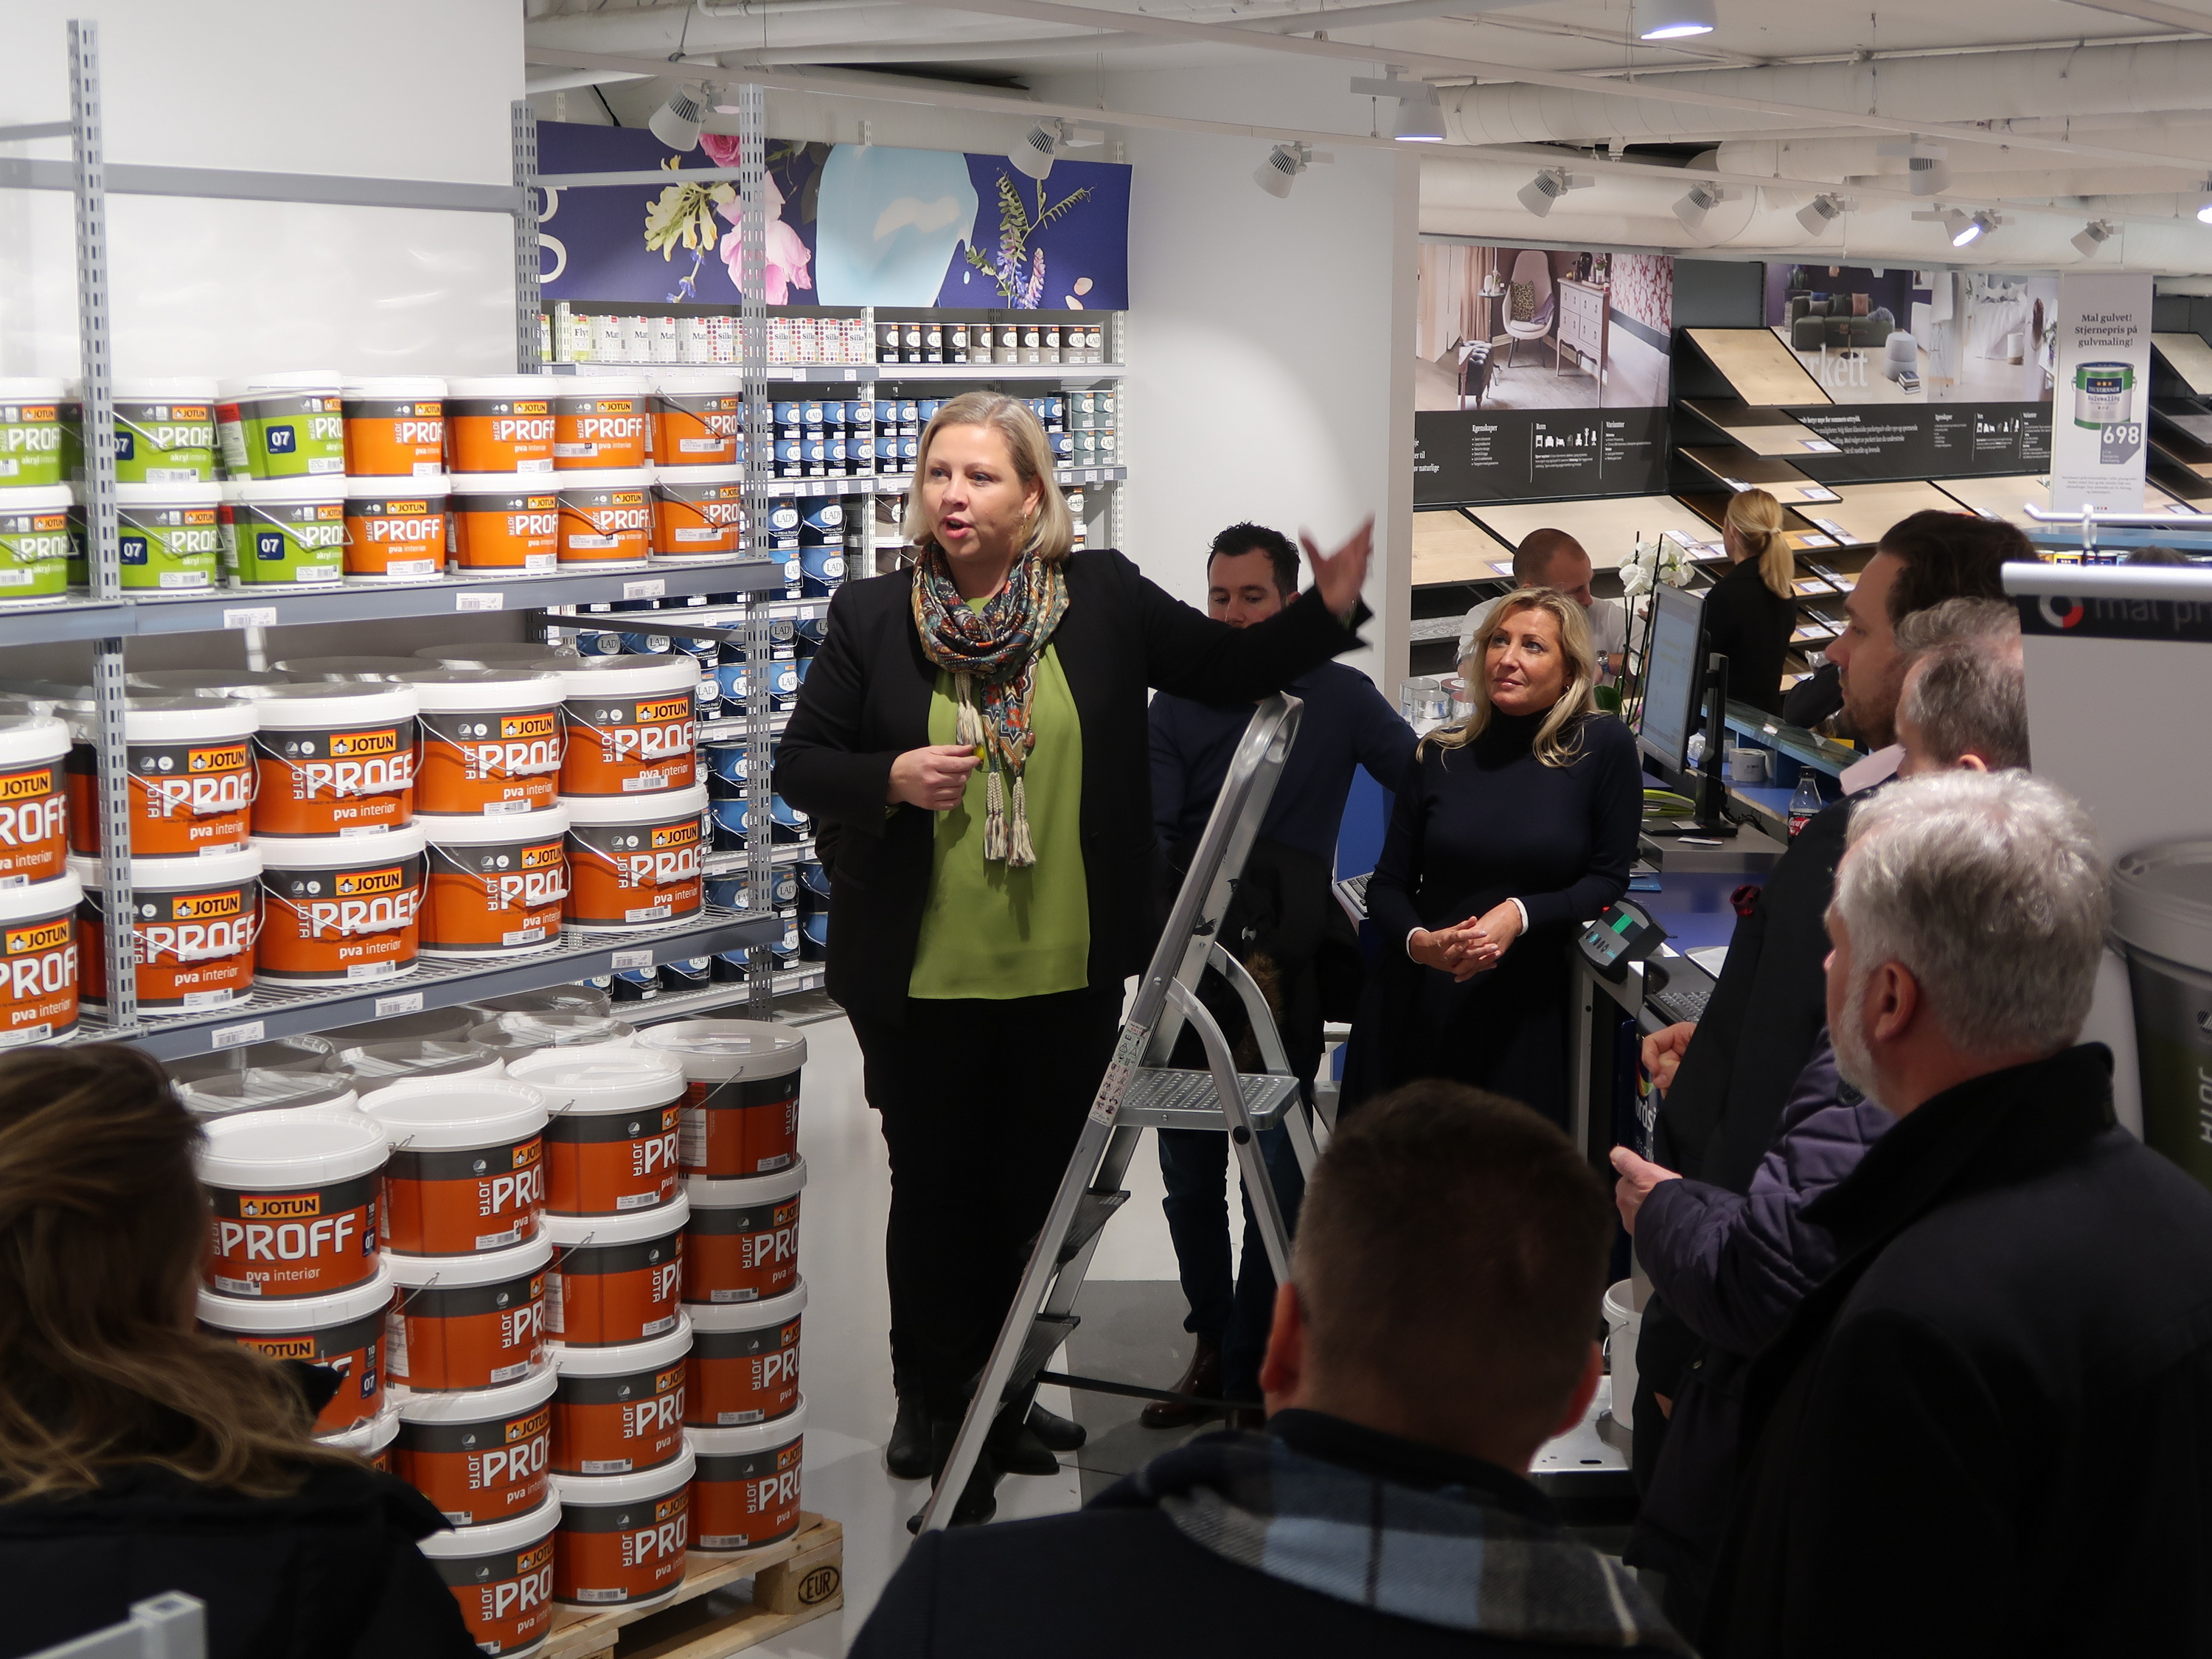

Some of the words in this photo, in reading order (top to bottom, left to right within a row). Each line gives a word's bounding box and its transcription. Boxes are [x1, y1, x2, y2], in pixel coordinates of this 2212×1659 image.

[2081, 313, 2098, 322] Mal
[2101, 313, 2132, 325] gulvet!
[2075, 325, 2125, 337] Stjernepris
[2126, 324, 2138, 335] på
[2078, 337, 2133, 349] gulvmaling!
[1804, 342, 1868, 387] rkett
[183, 409, 205, 418] JOTUN
[524, 403, 546, 412] JOTUN
[607, 402, 630, 411] JOTUN
[584, 417, 643, 439] PROFF
[2103, 425, 2139, 445] 698
[271, 431, 291, 448] 07
[515, 444, 528, 453] pva
[598, 441, 612, 450] pva
[622, 493, 641, 502] JOTUN
[398, 503, 425, 512] JOTUN
[776, 513, 796, 523] LADY
[365, 520, 373, 541] JOTA
[373, 518, 440, 541] PROFF
[123, 543, 142, 558] 07
[261, 538, 280, 554] 07
[389, 545, 403, 554] pva
[528, 539, 539, 548] pva
[774, 625, 793, 635] LADY
[698, 686, 717, 696] LADY
[653, 701, 687, 719] JOTUN
[519, 718, 552, 734] JOTUN
[350, 734, 394, 753] JOTUN
[615, 720, 694, 762] PROF
[208, 750, 244, 768] JOTUN
[639, 767, 659, 779] pva
[661, 762, 689, 778] interiør
[2, 776, 49, 796] JOTUN
[161, 771, 252, 818] PROF
[504, 787, 524, 800] pva
[0, 793, 66, 846] ROFF
[333, 807, 357, 821] pva
[361, 802, 397, 817] interiør
[190, 825, 212, 841] pva
[216, 821, 243, 835] interiør
[667, 826, 697, 844] JOTUN
[15, 850, 52, 868] interiør
[617, 856, 628, 888] JOTA
[355, 873, 400, 891] JOTUN
[194, 896, 237, 915] JOTUN
[654, 893, 672, 906] pva
[297, 902, 310, 939] JOTA
[524, 917, 540, 930] pva
[28, 925, 67, 948] JOTUN
[339, 946, 363, 959] pva
[366, 939, 402, 954] interiør
[0, 944, 79, 1000] ROF
[175, 973, 199, 987] pva
[203, 967, 238, 981] interiør
[12, 1009, 36, 1025] pva
[40, 999, 72, 1018] interiør
[633, 1143, 642, 1177] JOTA
[493, 1164, 540, 1214] PRO
[258, 1199, 316, 1216] JOTUN
[479, 1181, 490, 1217] JOTA
[514, 1217, 529, 1230] pva
[221, 1214, 355, 1261] PROFF
[365, 1234, 375, 1248] 07
[754, 1225, 798, 1267] PRO
[742, 1237, 751, 1269] JOTA
[246, 1270, 270, 1281] pva
[274, 1267, 321, 1281] interiør
[773, 1269, 787, 1284] pva
[501, 1315, 512, 1348] JOTA
[752, 1359, 761, 1391] JOTA
[763, 1344, 800, 1388] PRO
[364, 1374, 375, 1391] 07
[779, 1387, 793, 1402] pva
[636, 1386, 685, 1436] PRO
[623, 1405, 634, 1439] JOTA
[655, 1436, 671, 1452] pva
[468, 1455, 479, 1489] JOTA
[507, 1488, 526, 1504] pva
[758, 1464, 801, 1512] PRO
[747, 1482, 756, 1514] JOTA
[776, 1509, 790, 1526] pva
[622, 1534, 632, 1567] JOTA
[635, 1515, 687, 1568] PRO
[655, 1563, 671, 1580] pva
[495, 1563, 552, 1619] PRO
[806, 1571, 831, 1598] EUR
[481, 1587, 493, 1621] JOTA
[518, 1618, 535, 1634] pva
